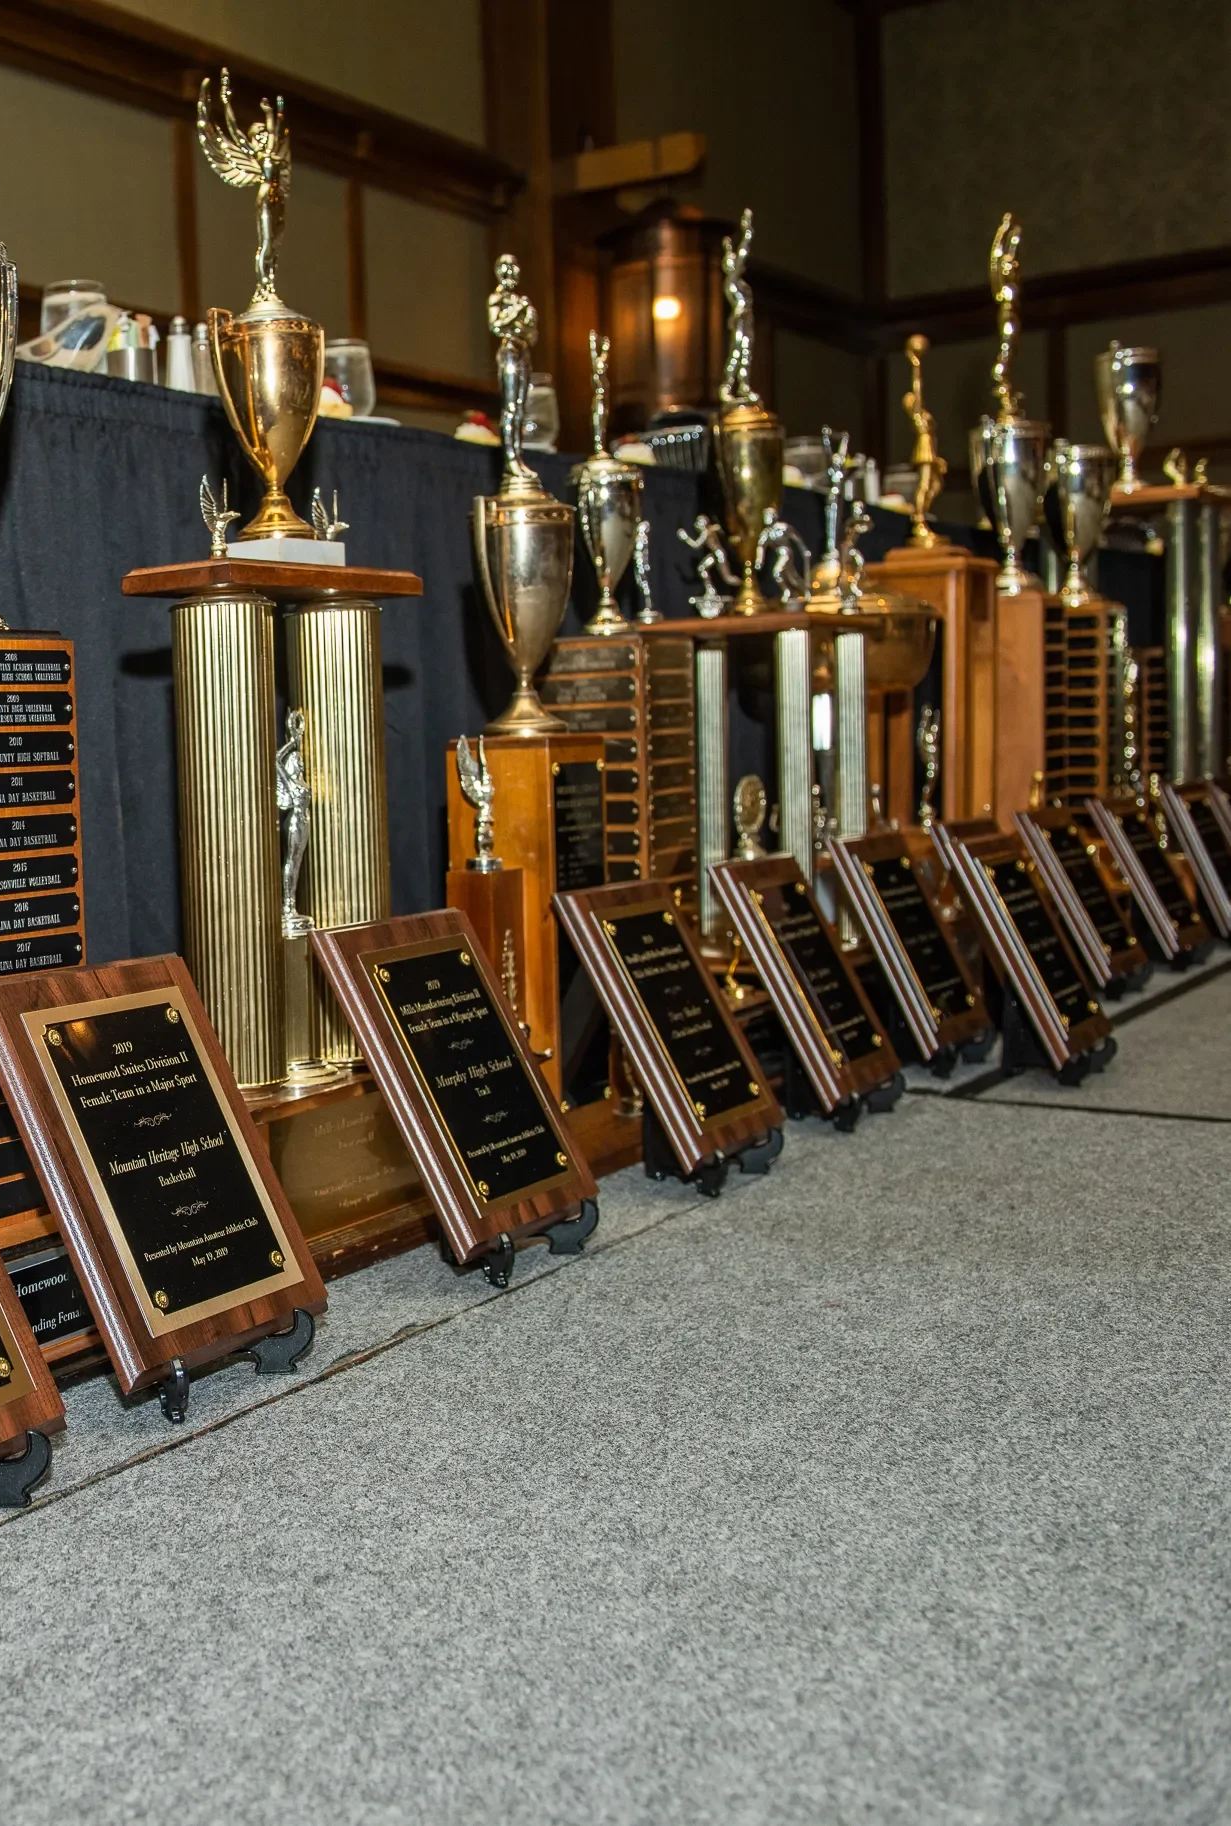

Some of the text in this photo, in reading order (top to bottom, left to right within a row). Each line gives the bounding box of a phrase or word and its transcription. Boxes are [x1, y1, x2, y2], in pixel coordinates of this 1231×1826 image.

[8, 736, 23, 747] 2010
[16, 752, 31, 763] HIGH
[32, 751, 60, 762] SOFTBALL
[10, 776, 23, 787] 2011
[8, 792, 20, 803] DAY
[21, 790, 56, 802] BASKETBALL
[28, 874, 62, 887] VOLLEYBALL
[16, 941, 32, 953] 2017
[15, 958, 28, 969] DAY
[29, 953, 63, 967] BASKETBALL
[399, 1003, 417, 1017] Mills
[413, 995, 456, 1013] Manufacturing
[451, 990, 476, 1004] Division
[407, 1020, 430, 1034] Female
[425, 1018, 444, 1029] Team
[451, 1008, 476, 1024] Olympic
[472, 1007, 489, 1020] Sport
[112, 1041, 133, 1055] 2019
[70, 1051, 189, 1087] Homewood Suites Division II
[435, 1055, 513, 1089] Murphy High School
[79, 1091, 113, 1109] Female
[110, 1088, 136, 1101] Team
[133, 1084, 146, 1096] in
[149, 1077, 176, 1092] Major
[174, 1073, 198, 1088] Sport
[108, 1132, 224, 1176] Mountain Heritage High School
[157, 1166, 197, 1187] Basketball
[143, 1216, 259, 1262] Presented by Mountain Amateur Athletic Club
[191, 1246, 229, 1267] May 19, 2019
